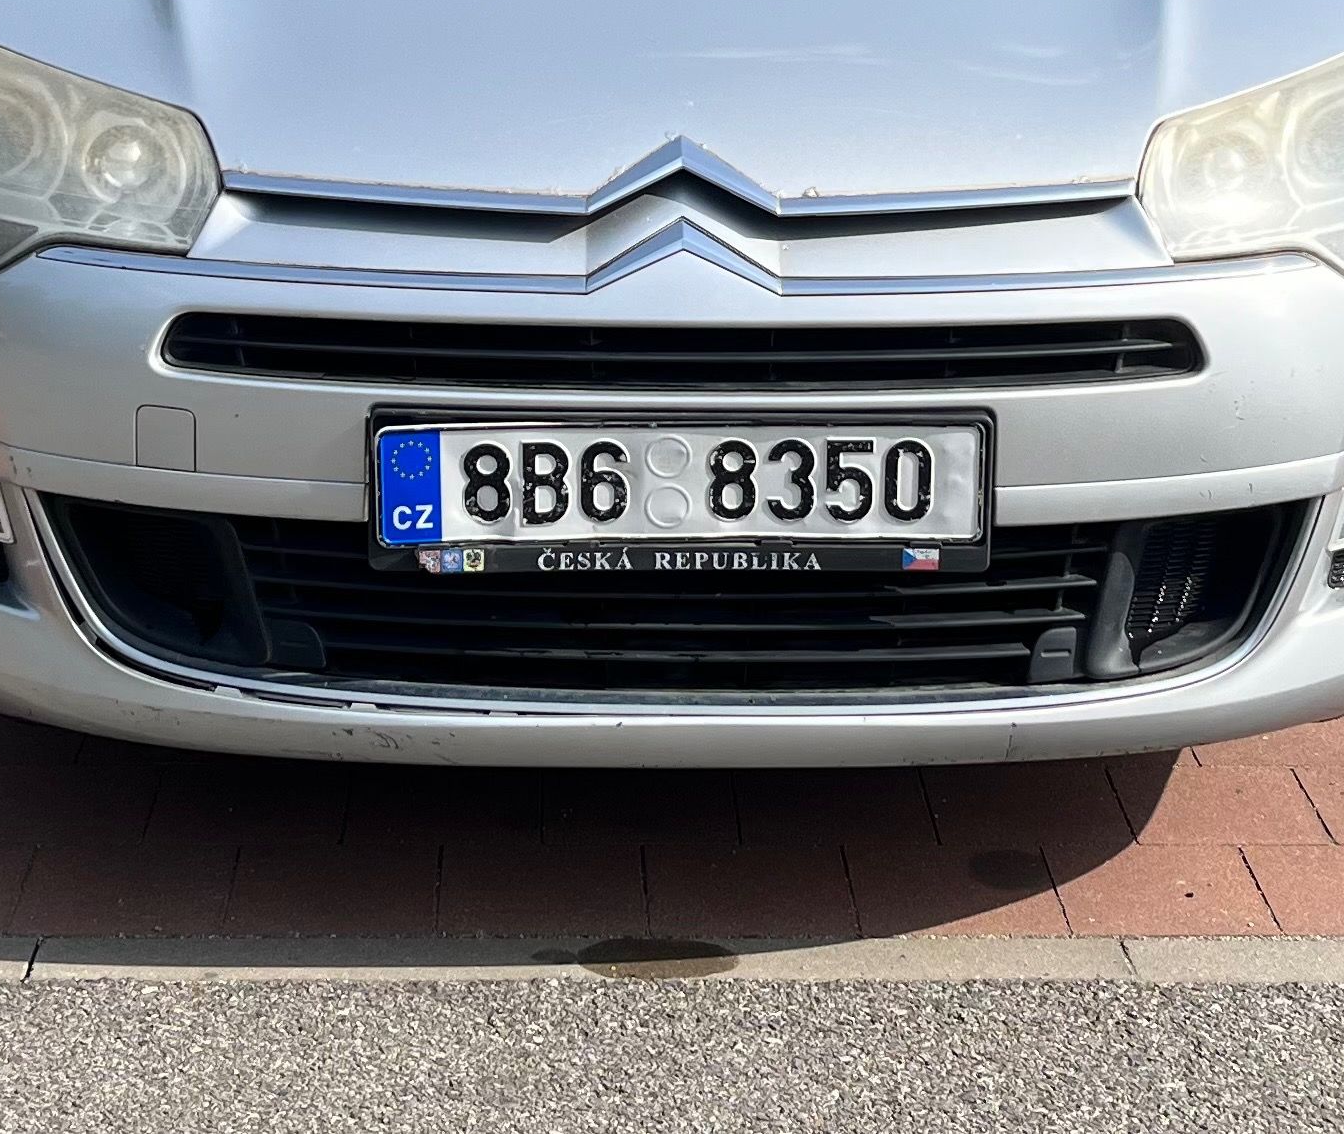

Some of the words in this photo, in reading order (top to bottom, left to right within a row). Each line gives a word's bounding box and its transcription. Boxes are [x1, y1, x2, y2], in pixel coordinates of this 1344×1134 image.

[461, 438, 630, 527] 8B6
[709, 436, 935, 525] 8350
[392, 505, 433, 530] CZ
[537, 546, 634, 571] ČESKÁ
[654, 552, 823, 571] REPUBLIKA
